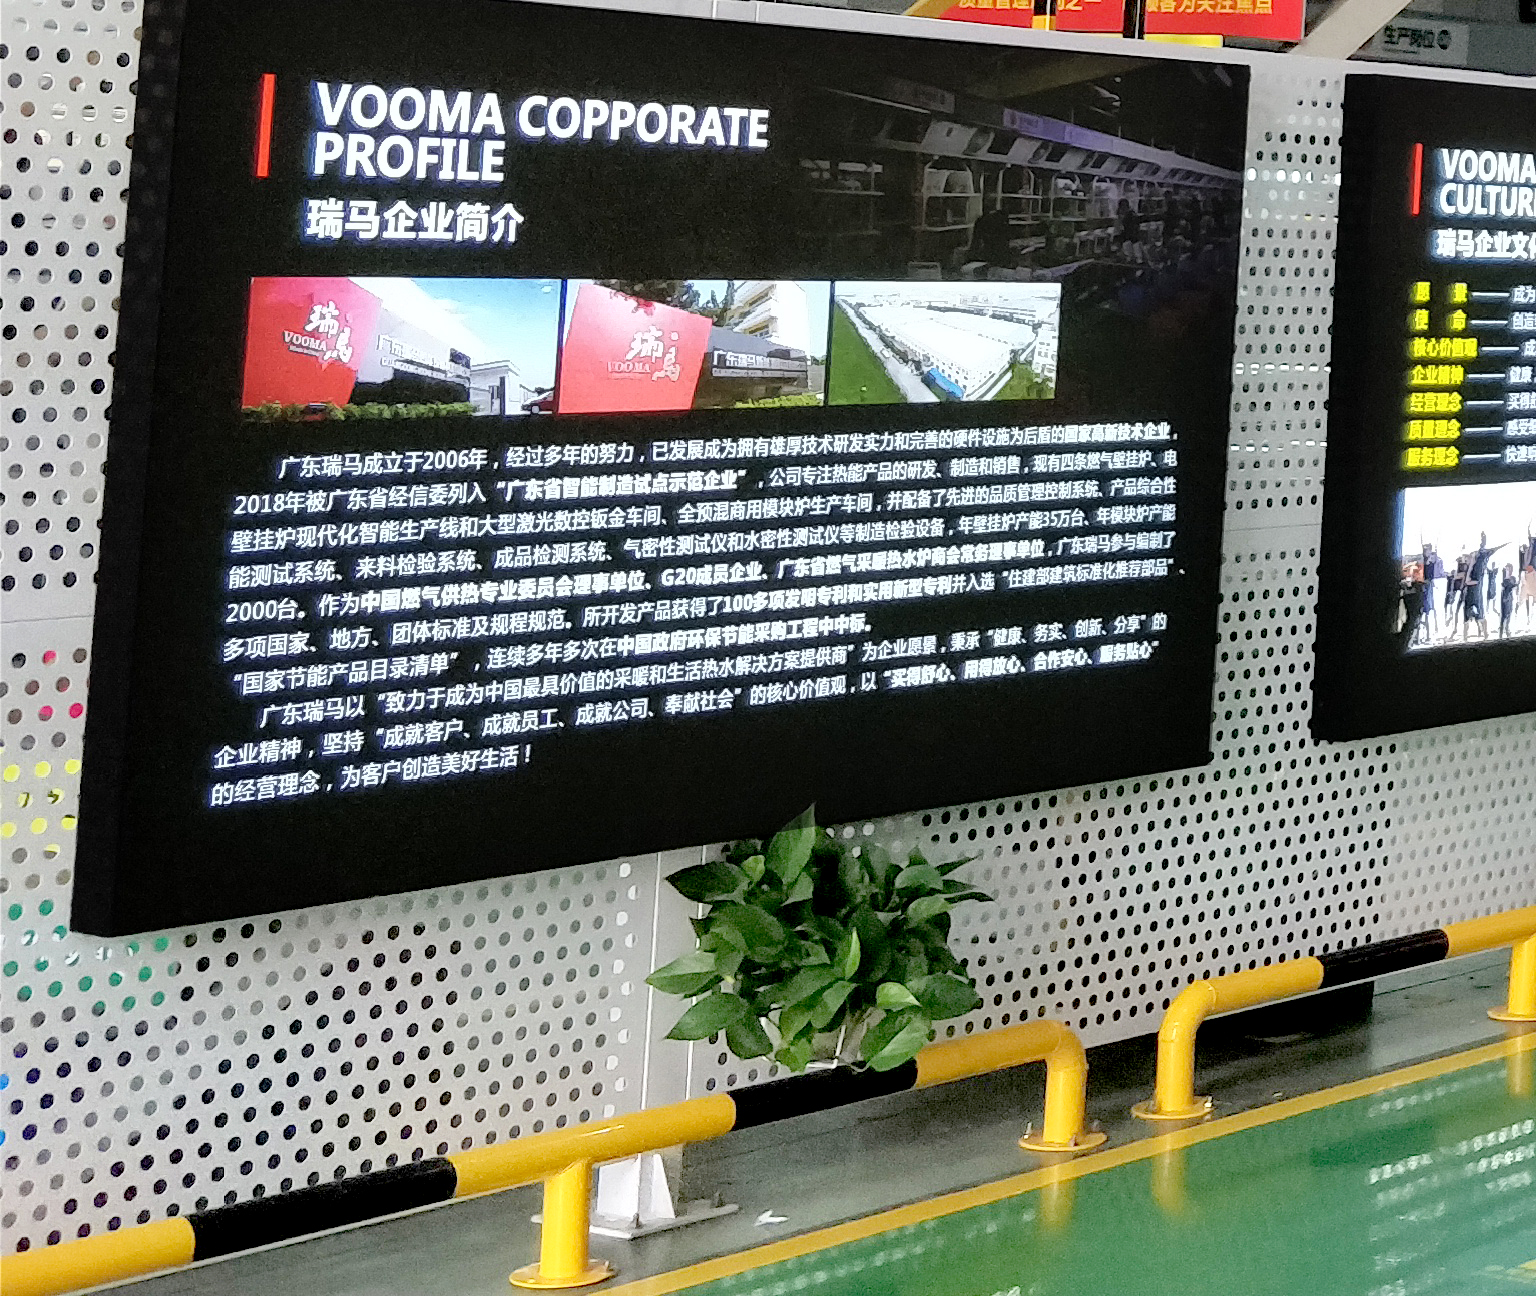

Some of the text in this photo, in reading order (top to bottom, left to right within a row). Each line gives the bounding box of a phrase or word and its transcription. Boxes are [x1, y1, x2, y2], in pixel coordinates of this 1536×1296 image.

[316, 82, 770, 148] VOOMA COPPORATE
[313, 132, 505, 182] PROFILE
[305, 198, 525, 243] 瑞马企业简介
[283, 330, 327, 352] VOOMA
